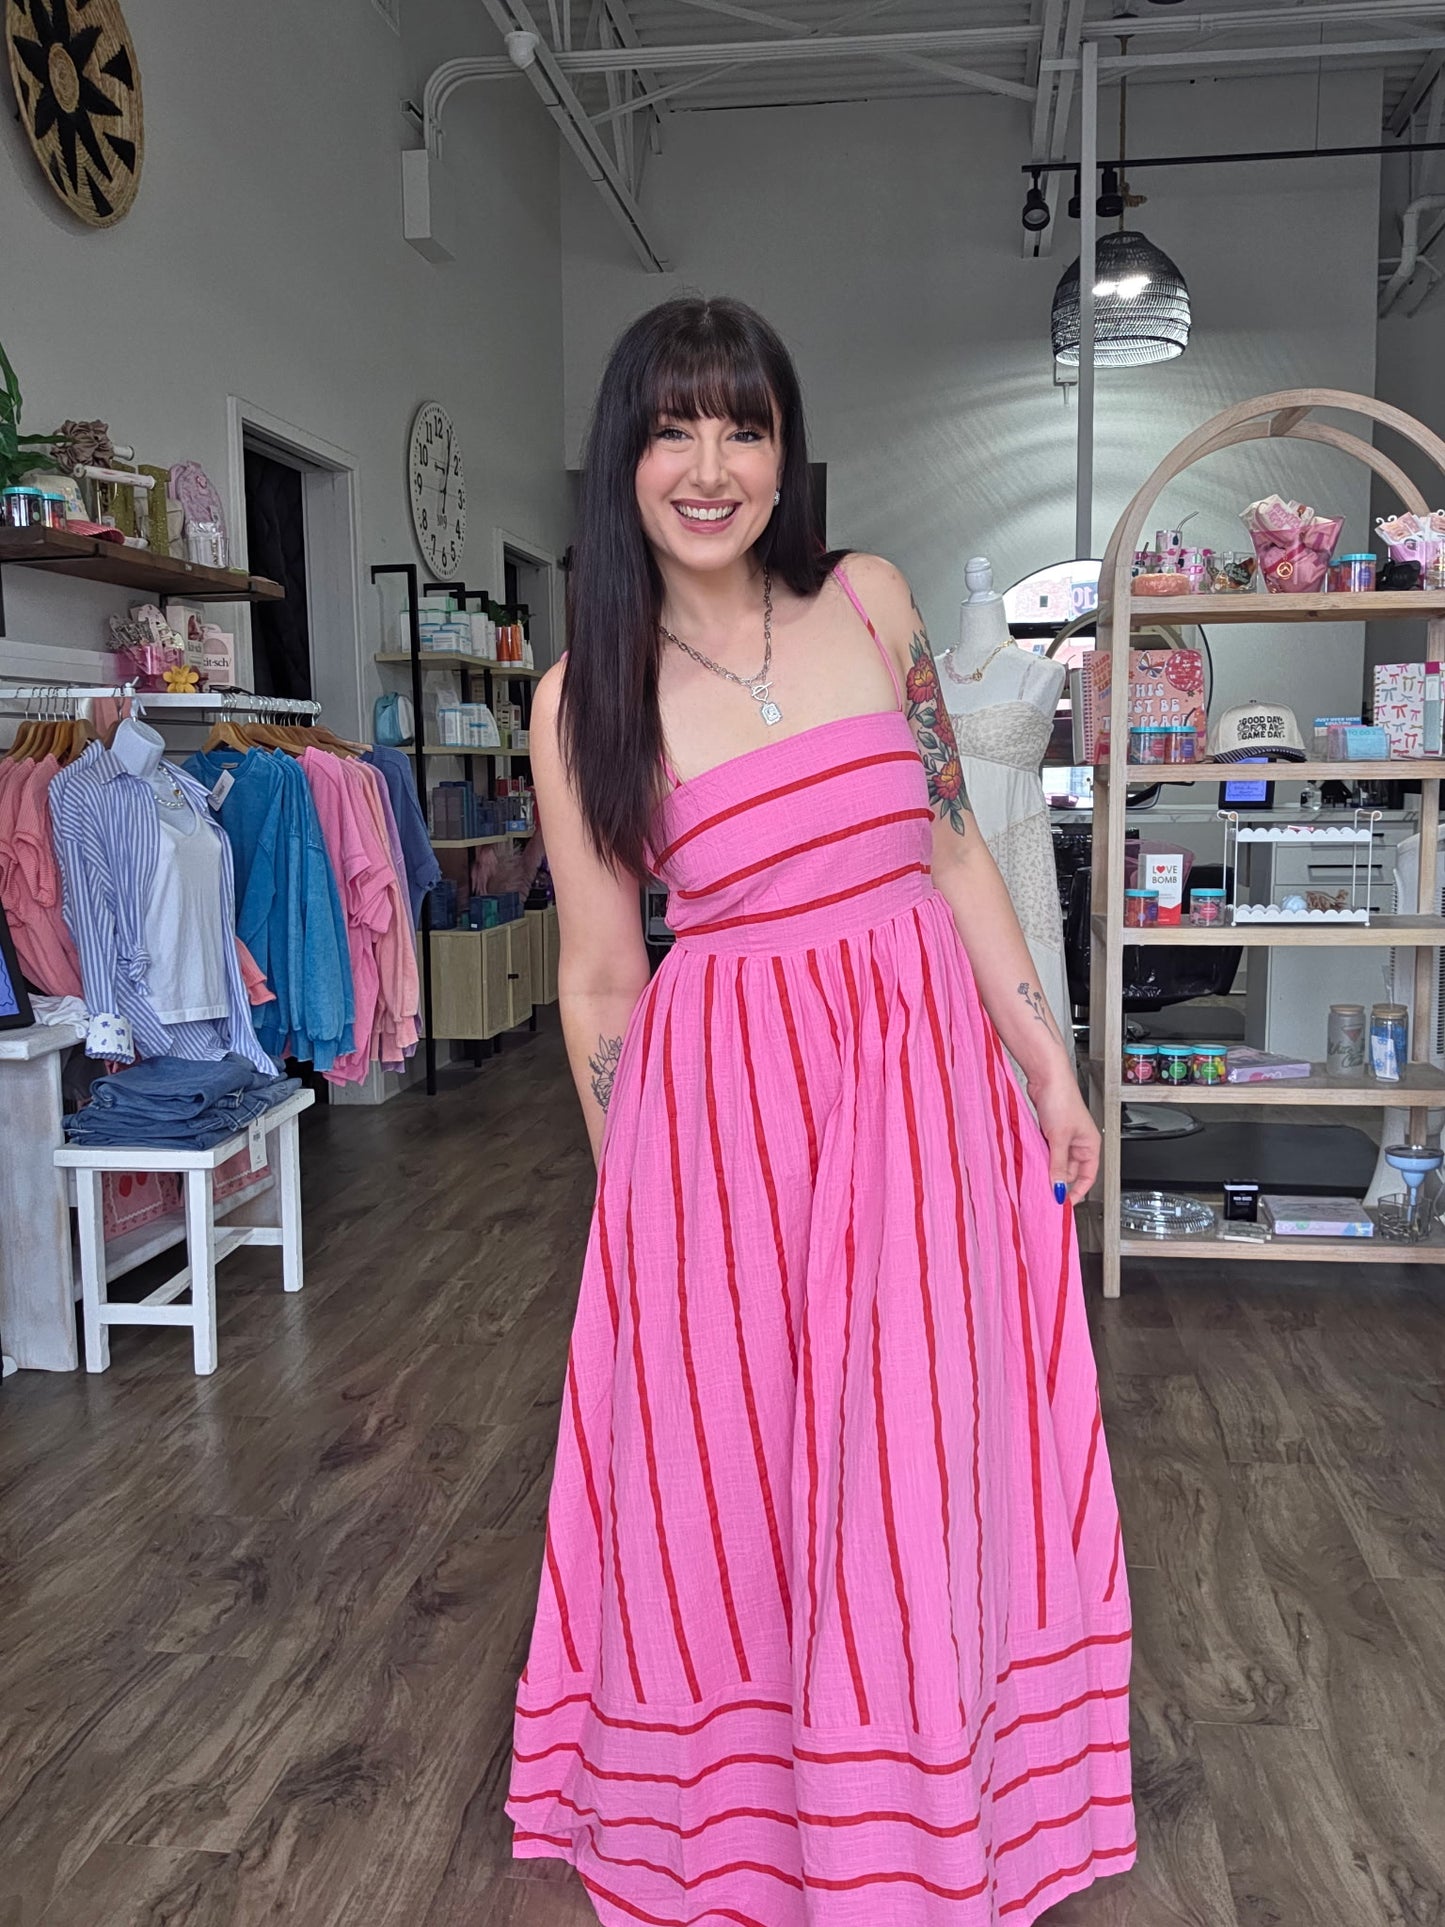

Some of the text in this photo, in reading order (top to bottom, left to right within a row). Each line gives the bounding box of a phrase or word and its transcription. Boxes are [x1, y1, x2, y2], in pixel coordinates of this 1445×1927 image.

[425, 421, 433, 445] 11
[434, 415, 443, 439] 12
[419, 443, 428, 467] 10
[454, 455, 459, 476] 2
[417, 473, 422, 495] 9
[458, 489, 463, 510] 3
[422, 508, 428, 531] 8
[456, 519, 461, 540] 4
[431, 534, 436, 555] 7
[451, 541, 456, 562] 5
[442, 547, 447, 568] 6
[1128, 682, 1164, 697] THIS
[1160, 698, 1180, 713] BE
[1242, 716, 1265, 725] GOOD
[1242, 731, 1265, 740] GAME
[1152, 876, 1177, 884] BOMB
